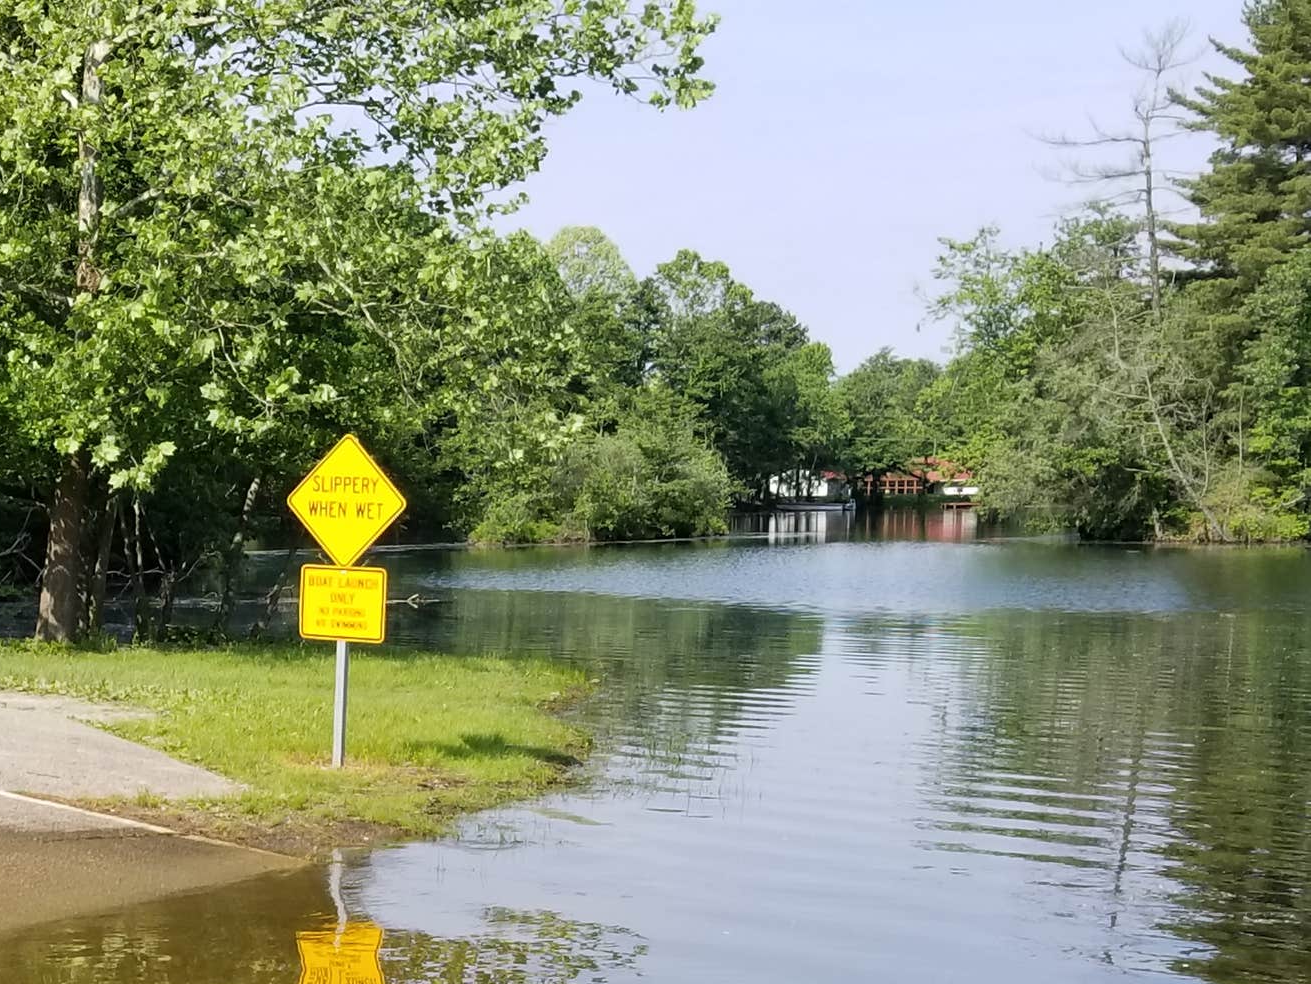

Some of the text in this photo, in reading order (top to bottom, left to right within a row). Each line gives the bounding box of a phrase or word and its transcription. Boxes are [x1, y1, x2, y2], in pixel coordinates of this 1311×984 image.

[312, 475, 379, 494] SLIPPERY
[308, 501, 384, 520] WHEN WET
[308, 575, 378, 589] BOAT LAUNCH
[330, 592, 355, 604] ONLY
